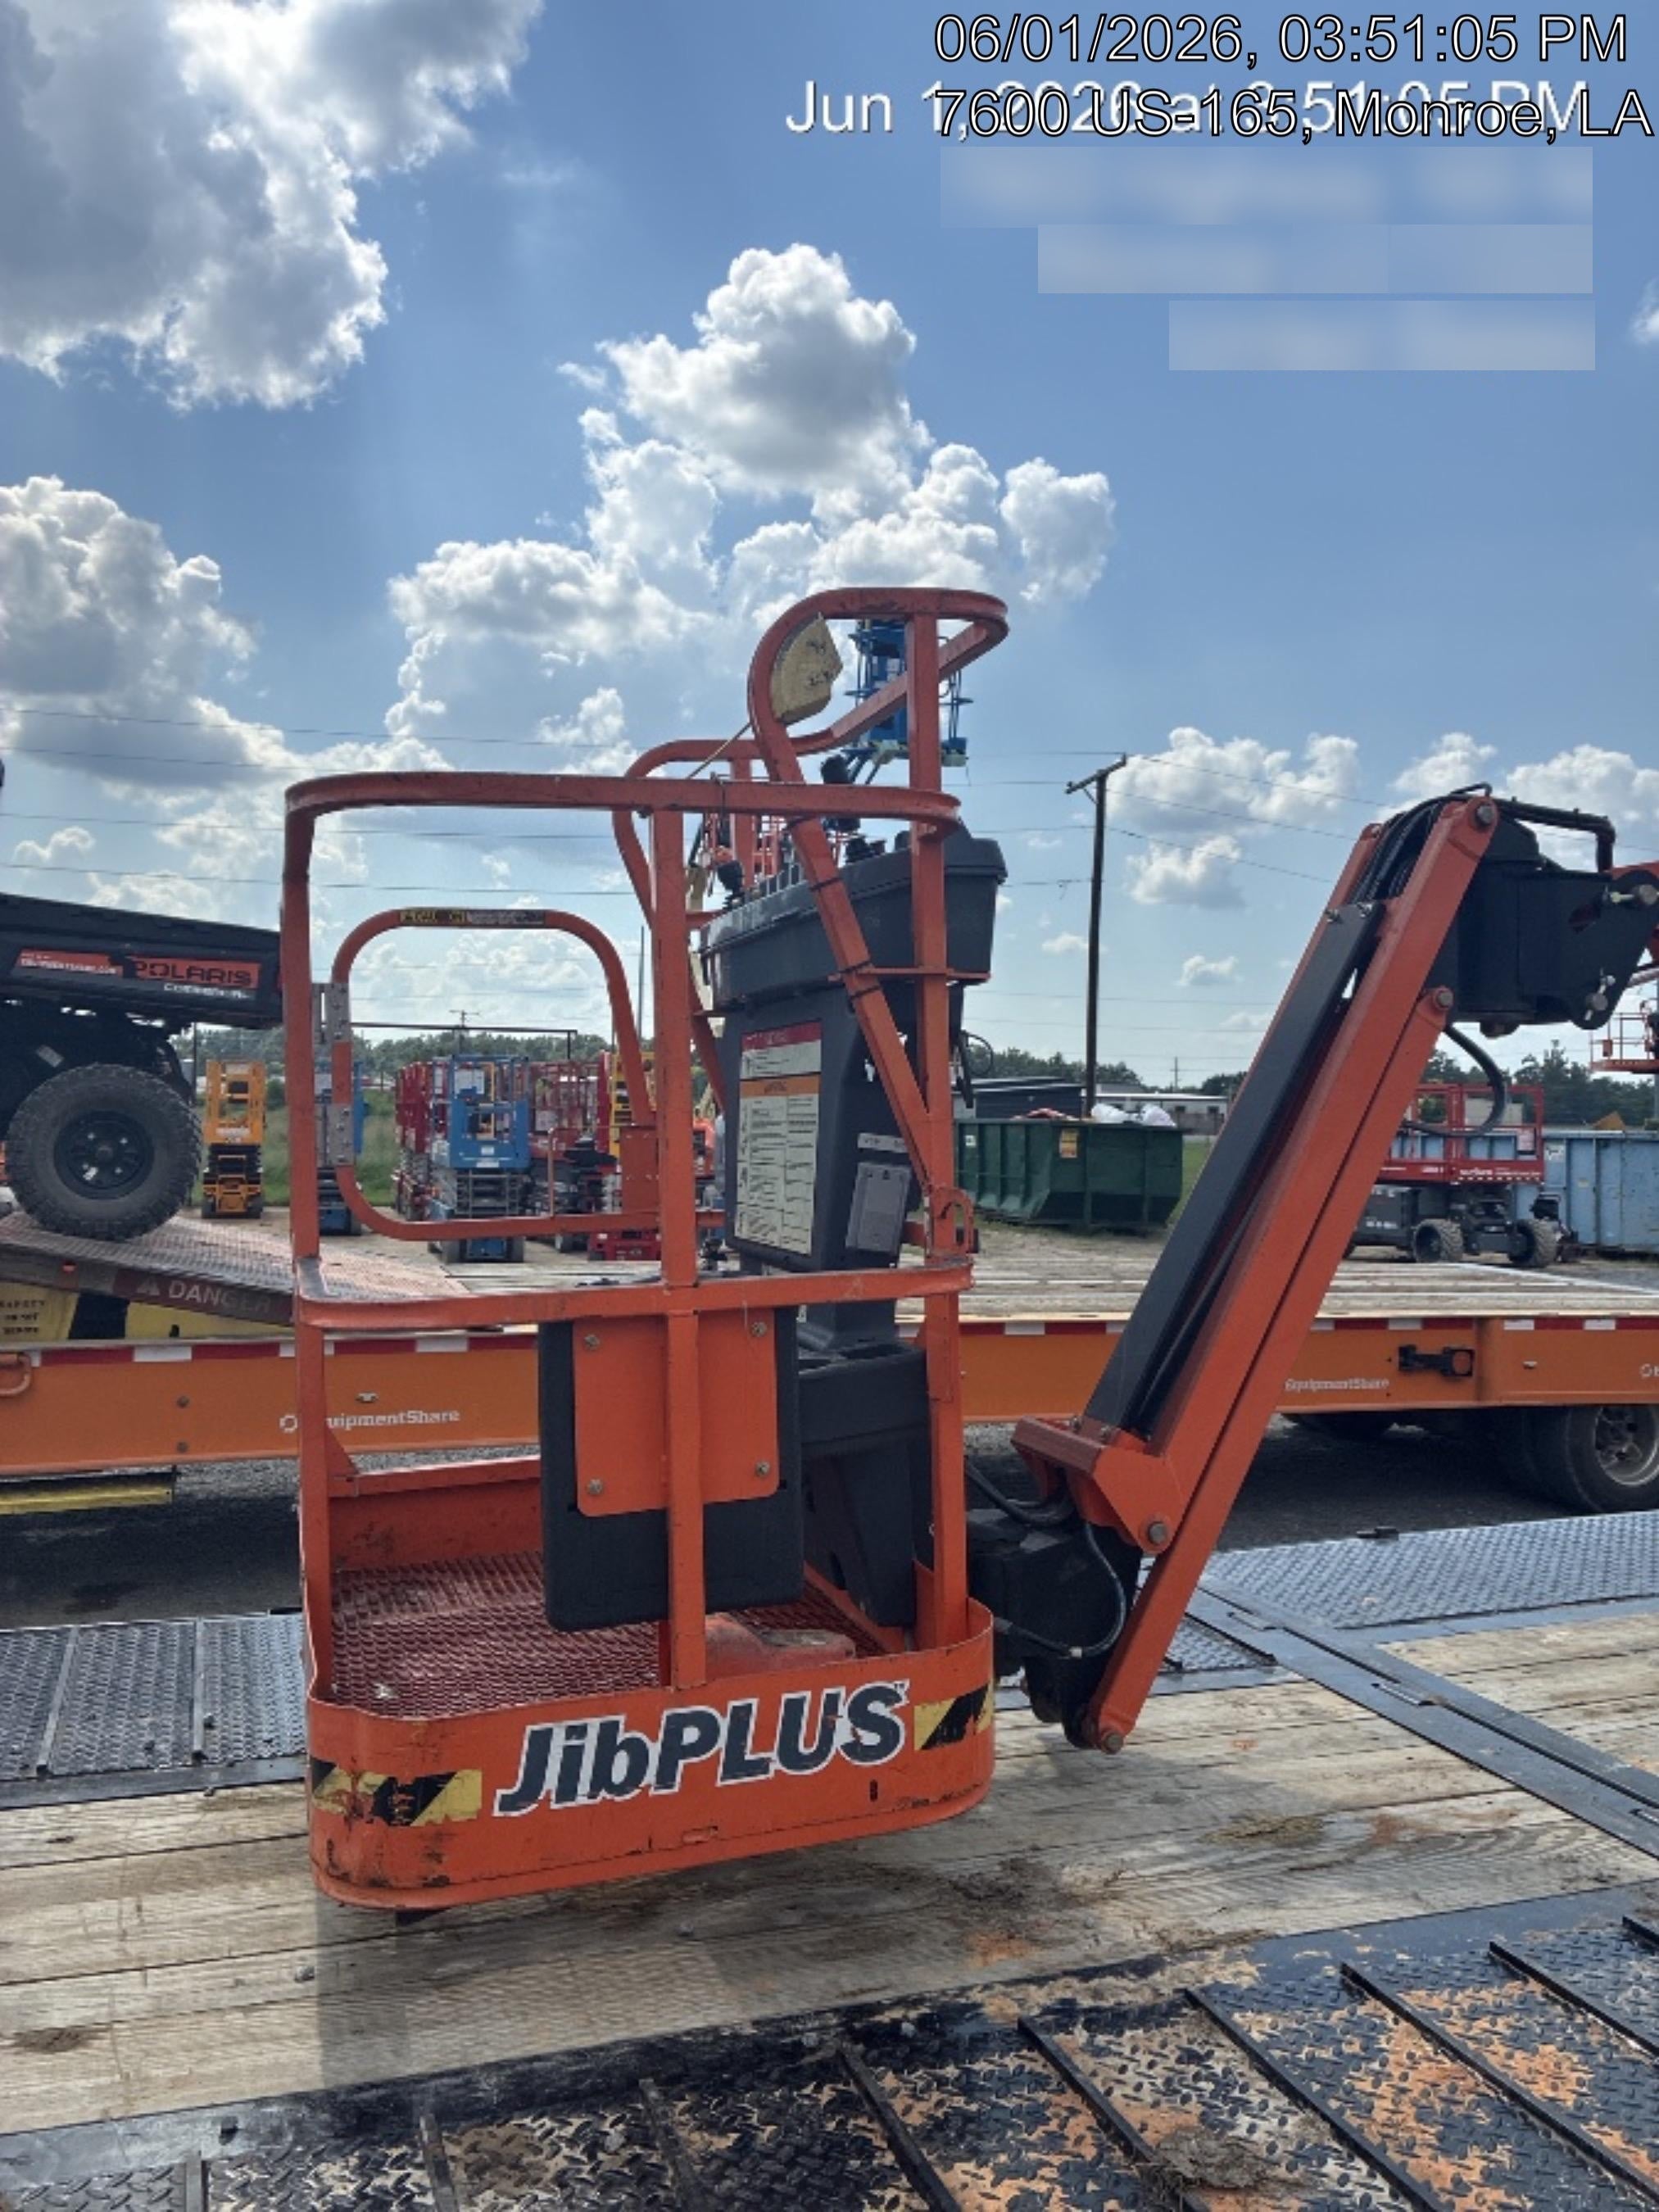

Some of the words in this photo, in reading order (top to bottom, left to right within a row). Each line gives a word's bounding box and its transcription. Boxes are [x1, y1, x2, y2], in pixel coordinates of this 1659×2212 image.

[134, 960, 252, 986] POLARIS
[326, 1409, 461, 1430] uipmentShare
[493, 1679, 909, 1817] JibPLUS
